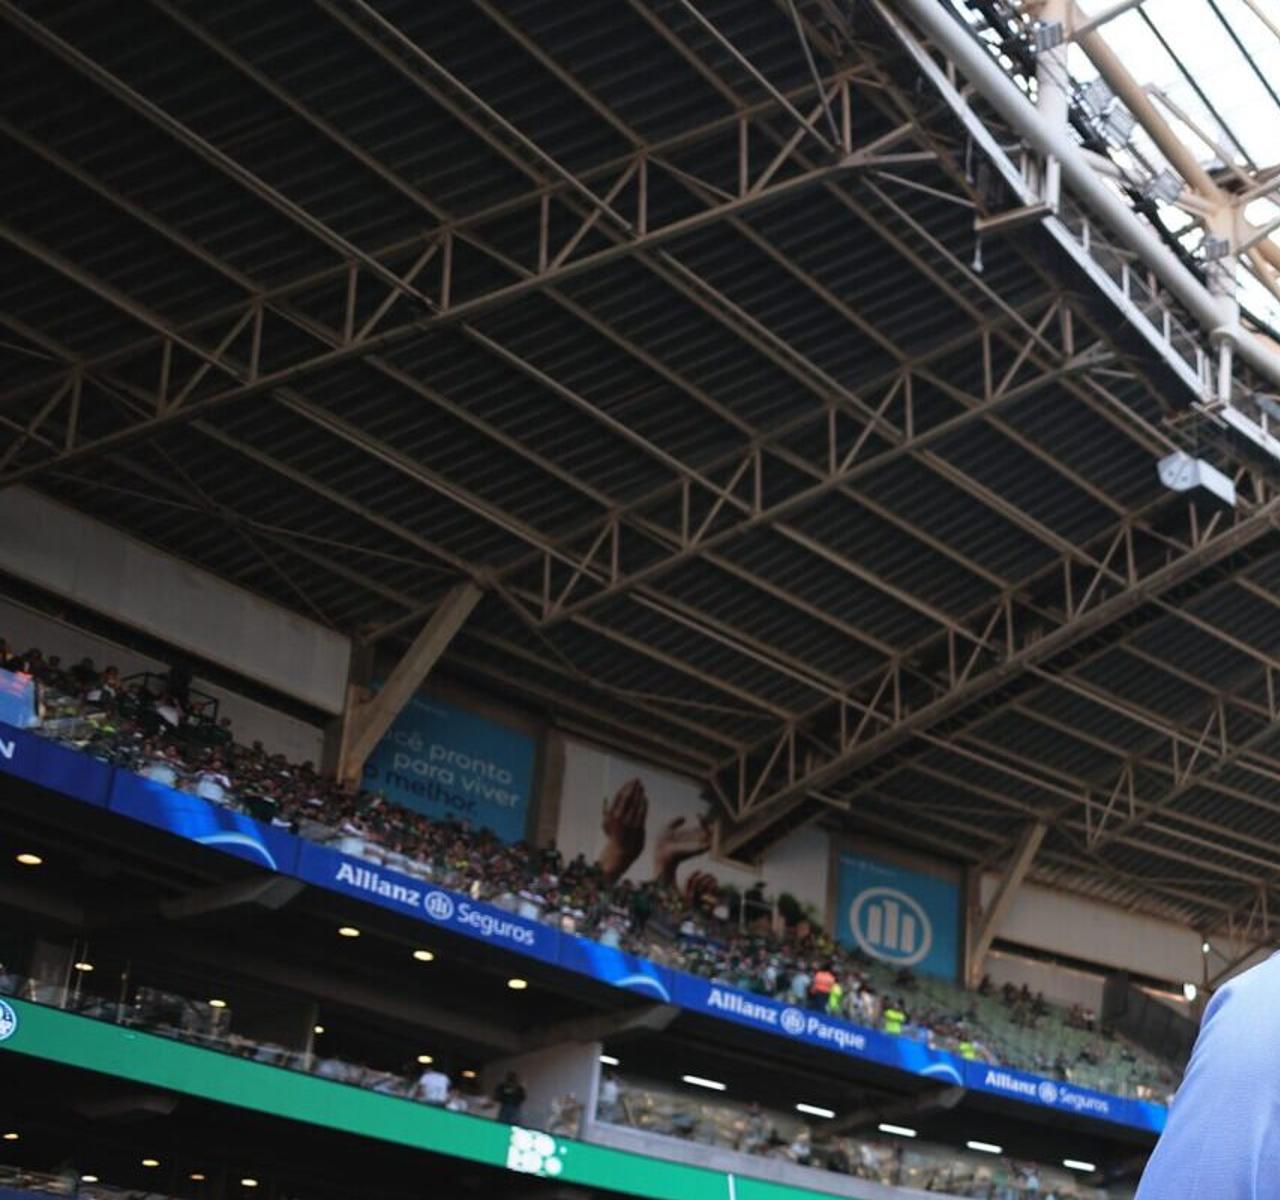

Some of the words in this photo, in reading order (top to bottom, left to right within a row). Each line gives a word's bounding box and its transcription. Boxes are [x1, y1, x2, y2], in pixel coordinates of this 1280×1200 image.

[393, 752, 454, 785] para
[462, 776, 520, 808] viver
[429, 744, 513, 785] pronto
[336, 862, 421, 907] Allianz
[457, 903, 535, 946] Seguros
[707, 988, 778, 1025] Allianz
[807, 1017, 866, 1050] Parque
[985, 1070, 1037, 1096] Allianz
[1059, 1087, 1109, 1114] Seguros
